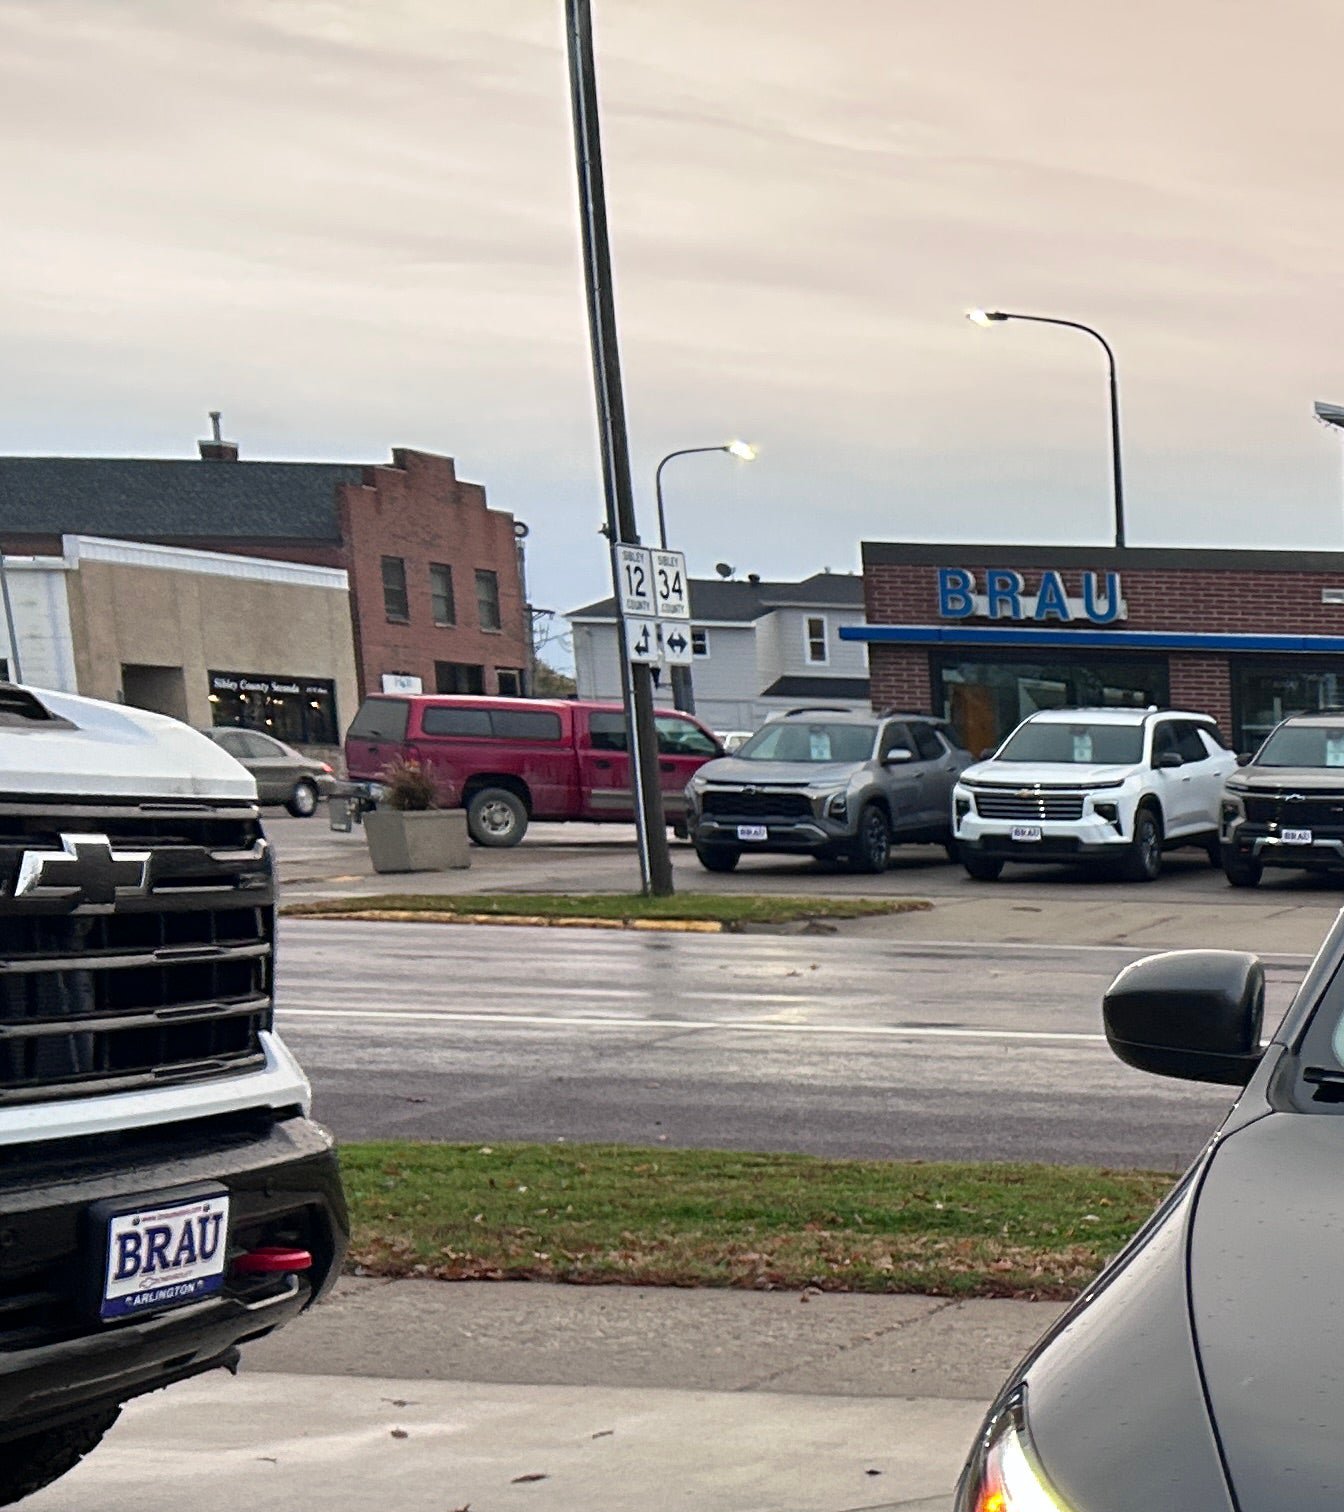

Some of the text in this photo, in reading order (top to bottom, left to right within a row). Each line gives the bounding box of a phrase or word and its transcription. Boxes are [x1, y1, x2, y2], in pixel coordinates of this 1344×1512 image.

[626, 564, 646, 598] 12
[658, 569, 682, 601] 34
[938, 567, 1121, 625] BRAU
[626, 599, 650, 611] COUNTY
[661, 603, 685, 614] COUNTY
[112, 1211, 224, 1283] BRAU
[133, 1281, 195, 1306] ARLINGTON
